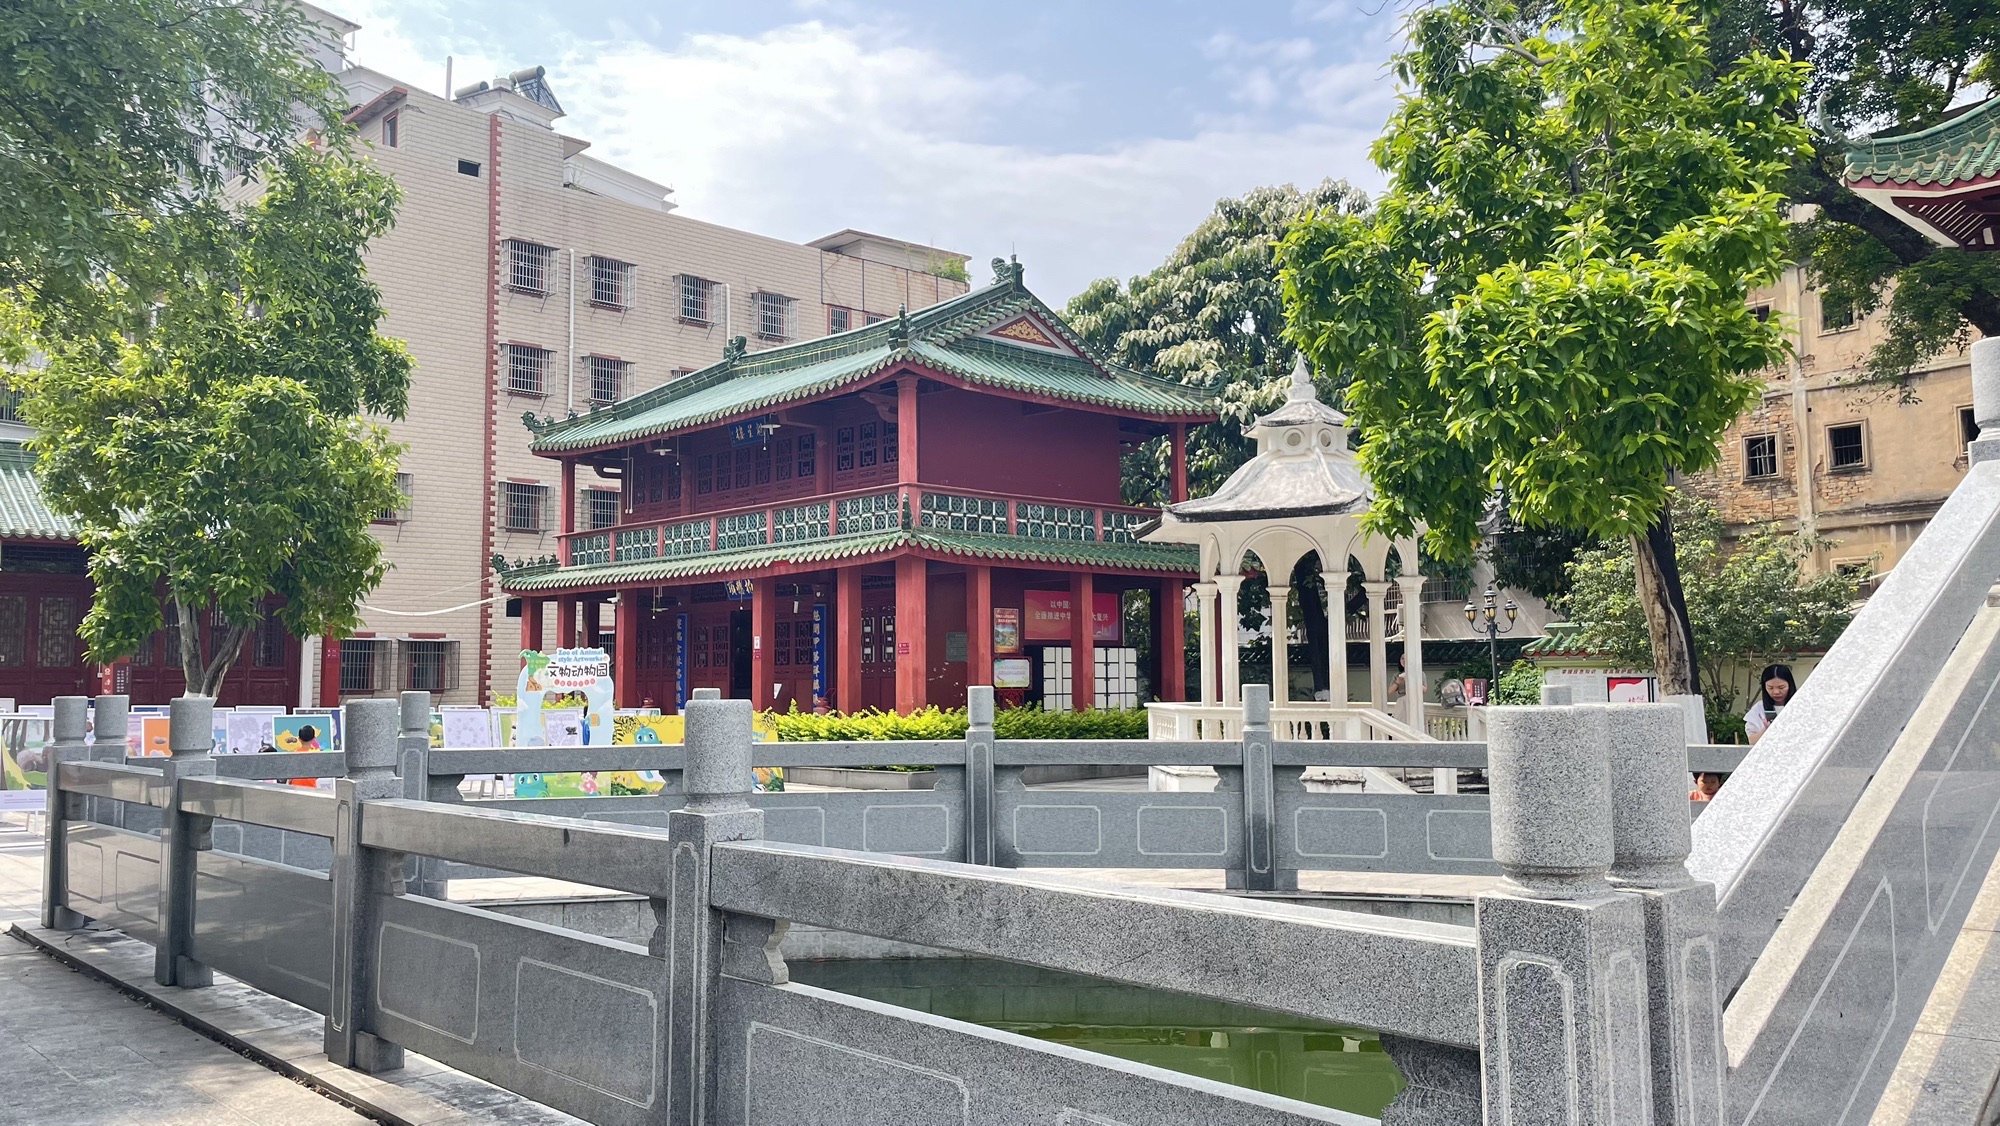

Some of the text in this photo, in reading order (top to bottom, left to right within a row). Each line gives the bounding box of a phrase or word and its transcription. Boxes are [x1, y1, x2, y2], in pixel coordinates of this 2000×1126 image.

[1050, 601, 1071, 609] 以中国
[547, 662, 607, 677] 文物动物园
